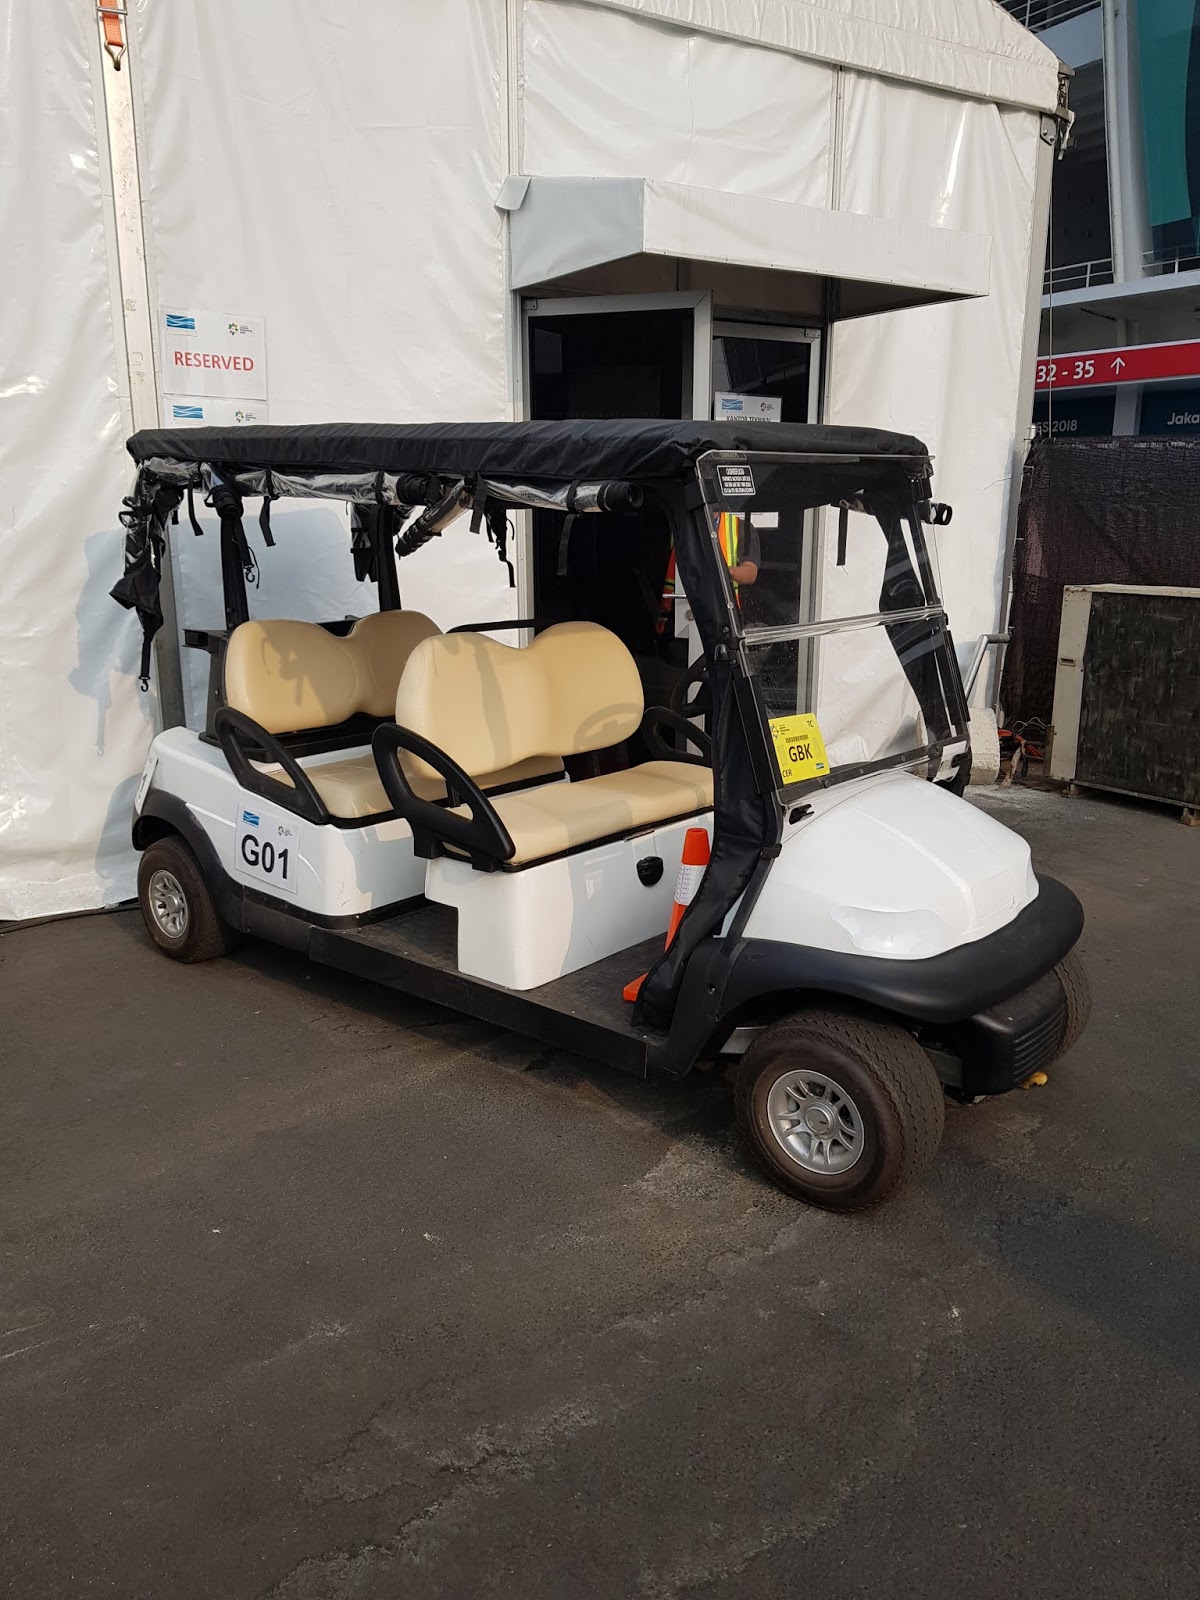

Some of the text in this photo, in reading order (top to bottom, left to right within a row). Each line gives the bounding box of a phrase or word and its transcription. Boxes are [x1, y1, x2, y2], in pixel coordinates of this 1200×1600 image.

[173, 351, 254, 371] RESERVED
[1036, 363, 1057, 383] 32
[1072, 359, 1095, 379] 35
[1052, 419, 1078, 432] 2018
[1167, 412, 1200, 425] Jaka
[788, 743, 813, 762] GBK
[241, 834, 288, 879] G01
